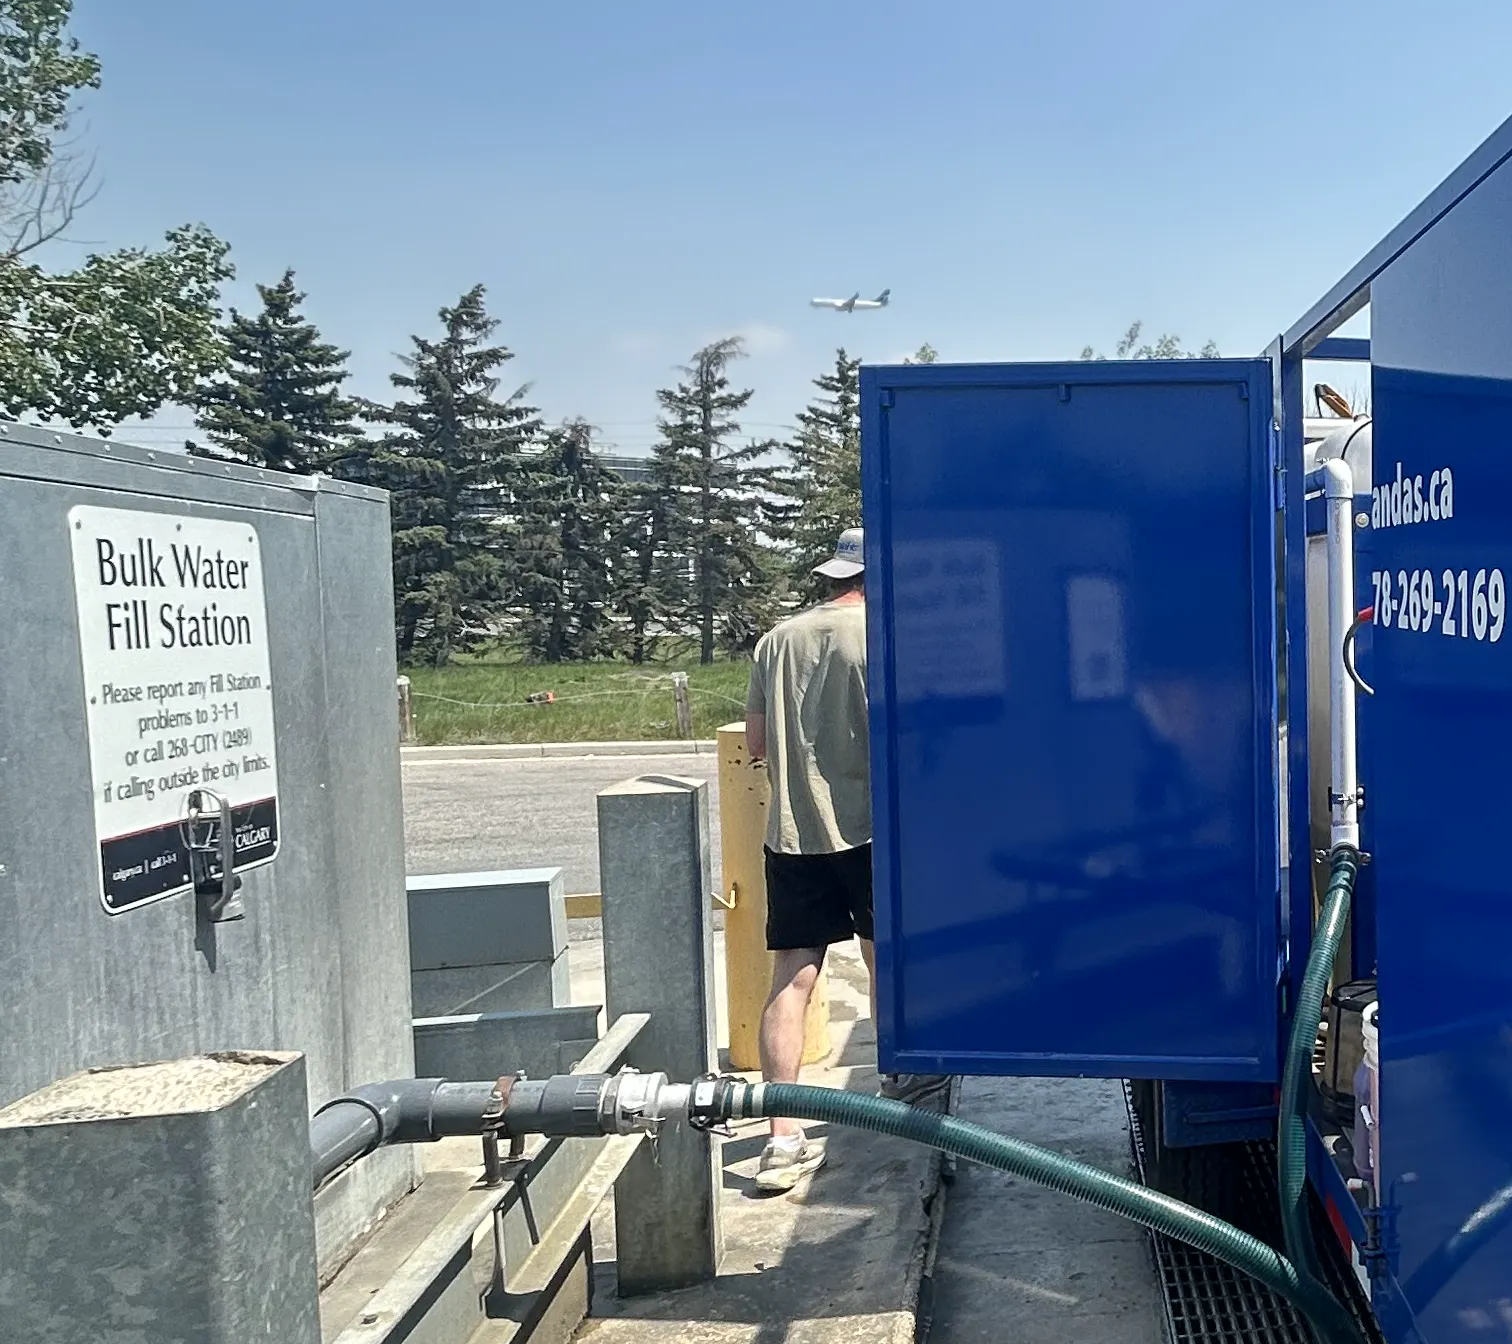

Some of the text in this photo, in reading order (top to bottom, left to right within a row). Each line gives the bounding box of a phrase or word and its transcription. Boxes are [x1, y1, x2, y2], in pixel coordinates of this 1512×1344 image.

[1371, 461, 1454, 531] andas.ca
[96, 537, 249, 590] Bulk Water
[106, 599, 252, 651] Fill Station
[1371, 568, 1506, 643] 78-269-2169
[101, 672, 262, 706] Please report any Fill Station
[138, 701, 239, 740] problems to 3-1-1
[125, 749, 140, 767] or
[143, 740, 165, 764] call
[167, 732, 220, 759] 268-CITY
[103, 752, 271, 803] if calling outside the city limits.
[235, 826, 272, 849] CALGARY
